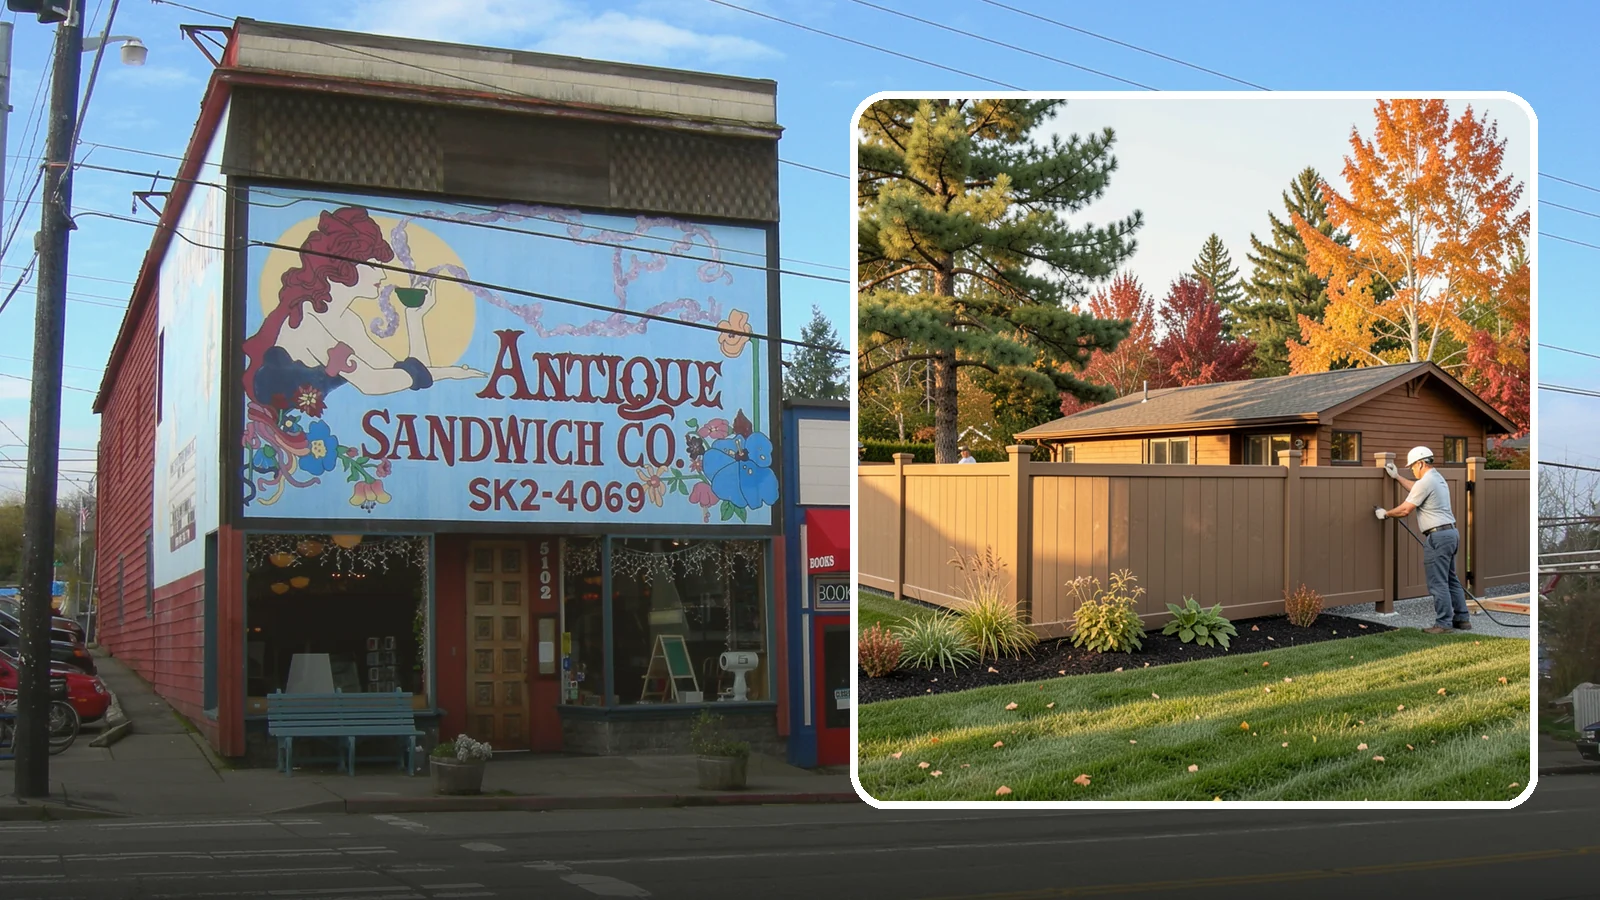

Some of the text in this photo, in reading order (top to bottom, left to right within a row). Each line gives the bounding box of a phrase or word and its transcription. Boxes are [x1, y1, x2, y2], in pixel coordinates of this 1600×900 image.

[476, 329, 723, 420] ANTIQUE
[362, 409, 686, 468] SANDWICH CO.
[468, 477, 646, 513] SK2-4069
[540, 541, 551, 599] 5102
[810, 555, 835, 568] BOOKS
